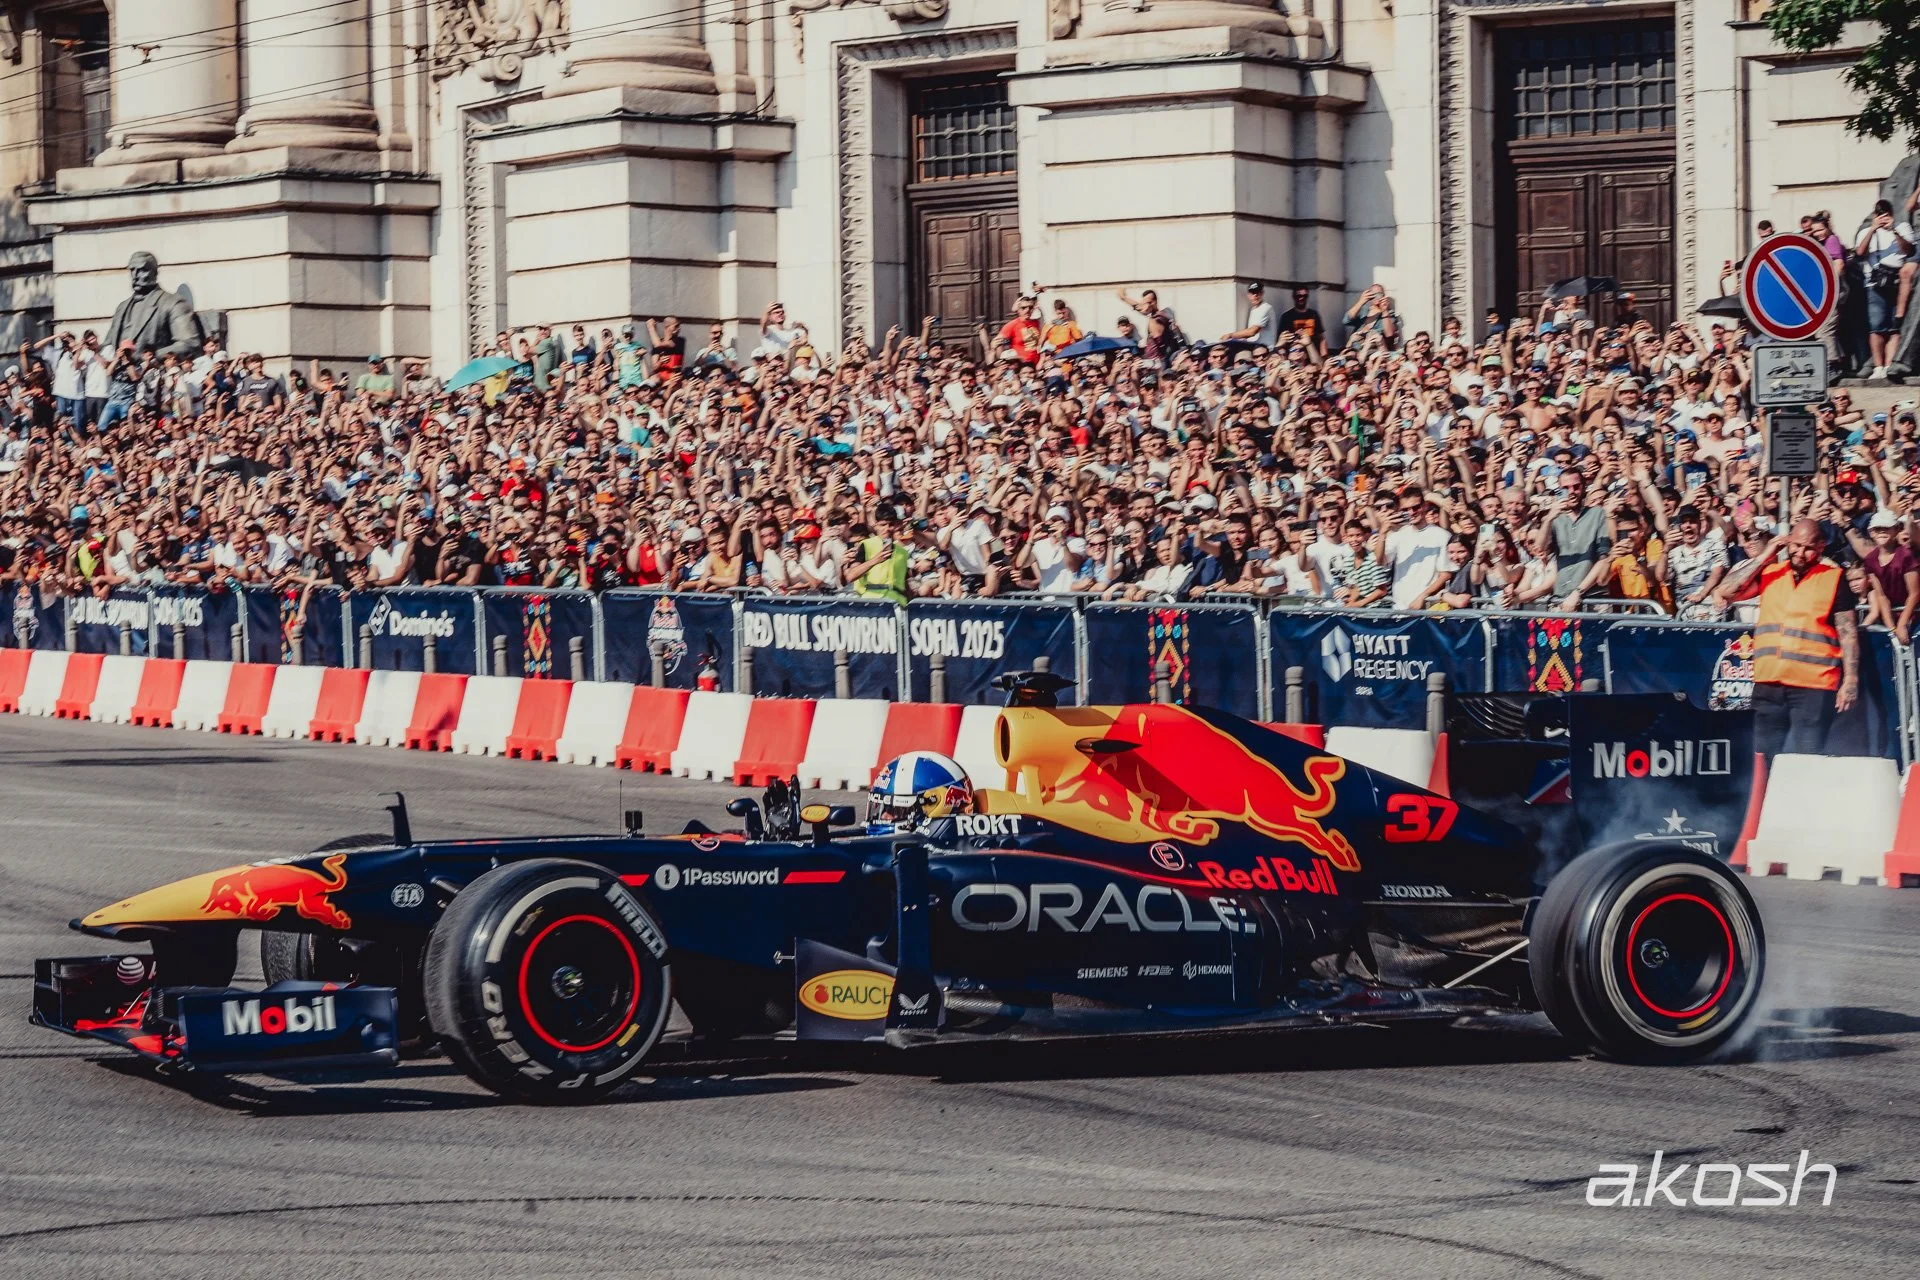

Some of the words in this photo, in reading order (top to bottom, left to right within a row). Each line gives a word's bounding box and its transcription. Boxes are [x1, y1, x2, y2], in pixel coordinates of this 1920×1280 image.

[743, 611, 774, 648] RED
[773, 614, 812, 651] BULL
[811, 614, 897, 655] SHOWRUN
[910, 617, 960, 657] SOFIA
[960, 619, 1005, 659] 2025
[1352, 634, 1411, 656] HYATT
[1353, 659, 1434, 681] REGENCY
[1592, 740, 1694, 778] Mobil
[955, 814, 1022, 836] ROKT
[1384, 793, 1460, 843] 37
[682, 867, 780, 886] 1Password
[1197, 856, 1280, 891] Red
[1270, 857, 1339, 896] Bull
[393, 888, 421, 904] FIA
[1381, 884, 1452, 899] HONDA
[604, 881, 669, 960] PIRELLI
[951, 881, 1257, 934] ORACLE
[1077, 966, 1129, 979] SIEMENS
[1198, 964, 1232, 975] HEXAGON
[222, 995, 338, 1036] Mobil
